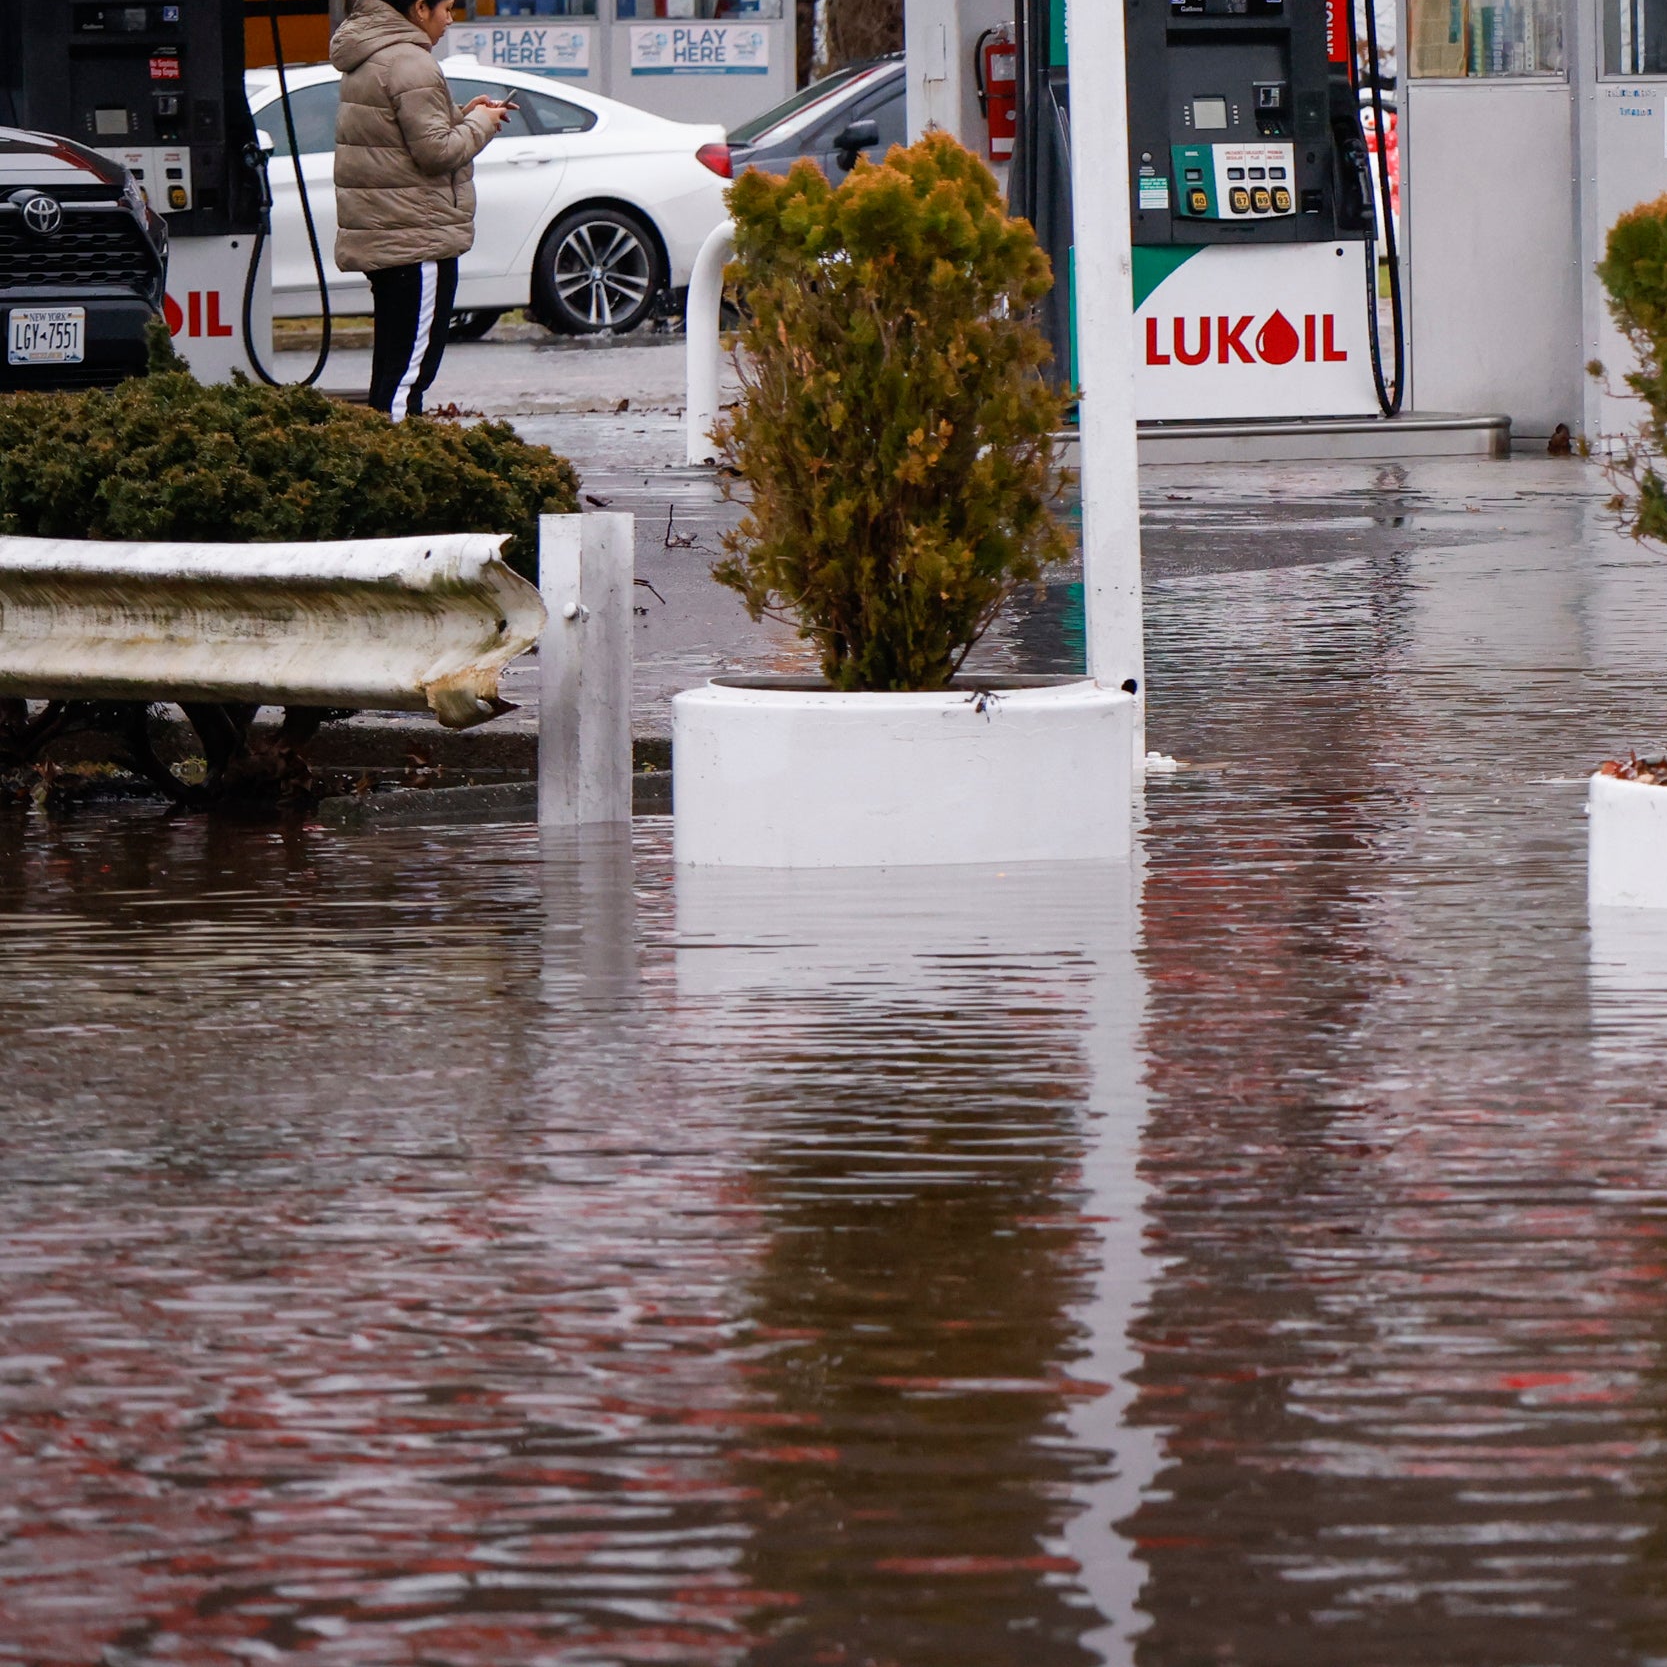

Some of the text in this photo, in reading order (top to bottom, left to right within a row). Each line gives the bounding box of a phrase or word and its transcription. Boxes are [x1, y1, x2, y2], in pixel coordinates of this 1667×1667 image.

[491, 30, 549, 47] PLAY
[673, 29, 727, 46] PLAY
[491, 47, 548, 64] HERE
[673, 46, 727, 63] HERE
[1277, 197, 1288, 205] 93
[29, 312, 67, 323] NEW YORK
[1145, 309, 1348, 367] LUKOIL
